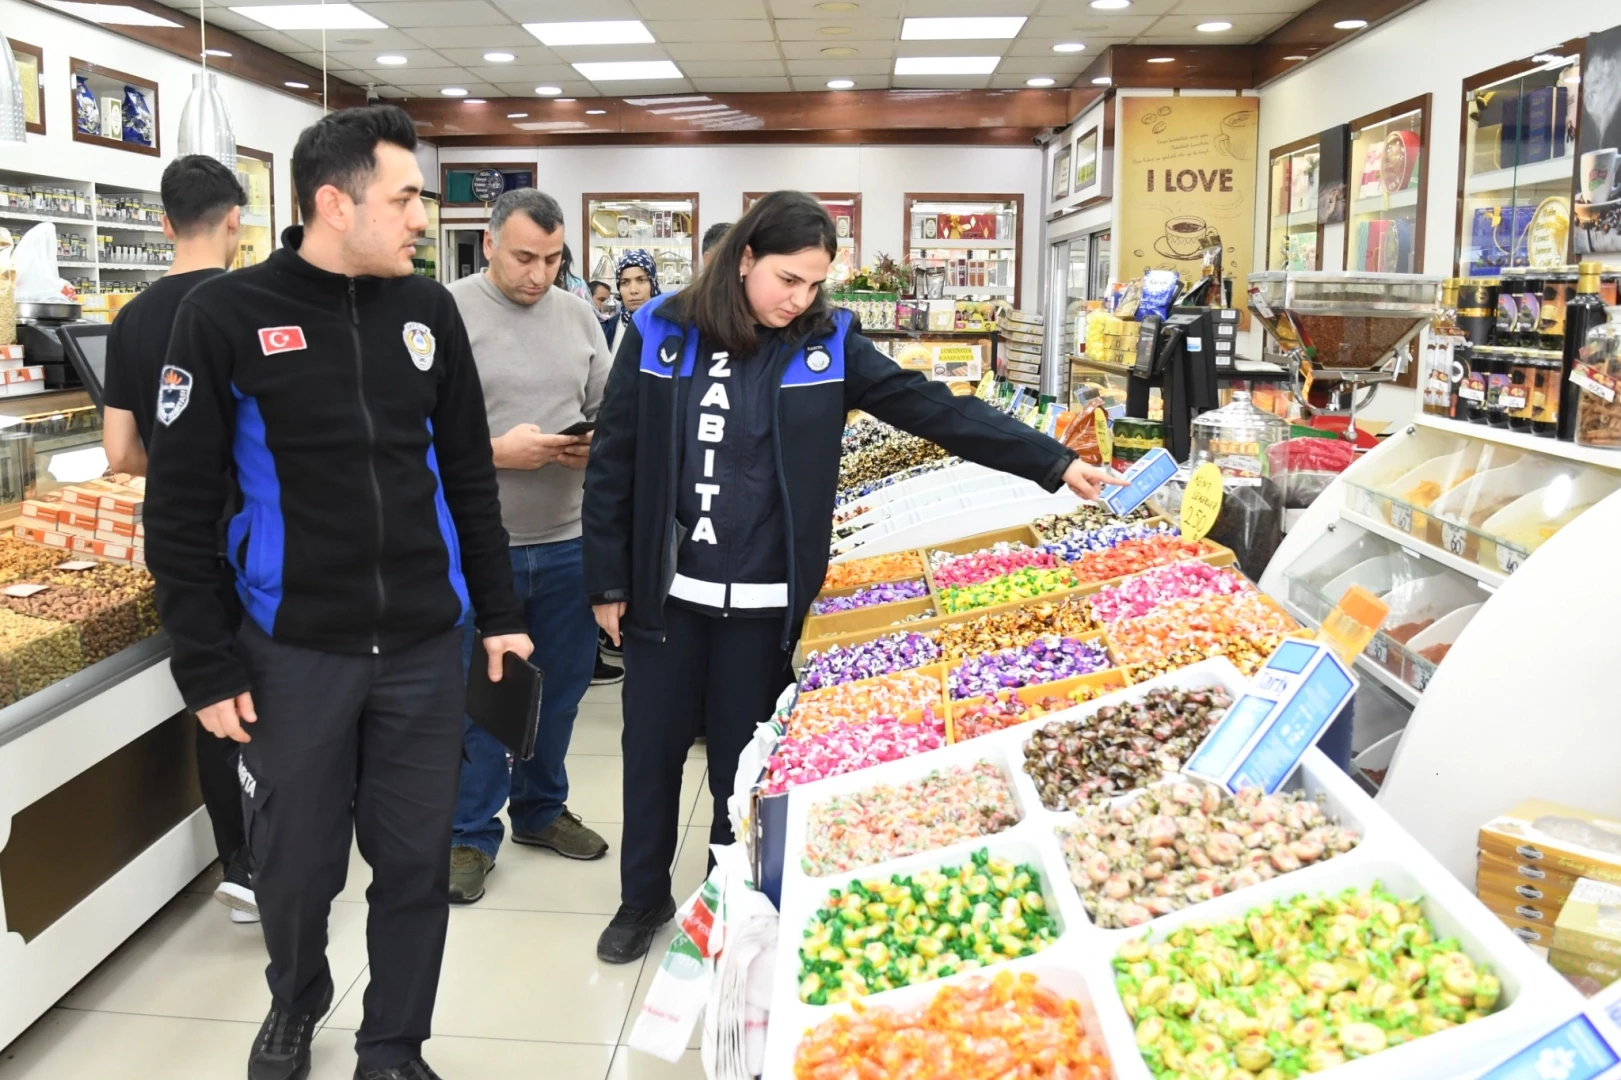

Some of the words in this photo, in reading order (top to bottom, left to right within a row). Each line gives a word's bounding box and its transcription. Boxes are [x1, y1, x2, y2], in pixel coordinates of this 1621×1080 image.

[1146, 169, 1155, 192] I
[1165, 168, 1233, 193] LOVE
[691, 351, 731, 545] ZABITA
[1195, 475, 1212, 491] KENT
[1183, 505, 1207, 532] 250
[1450, 535, 1461, 555] 60
